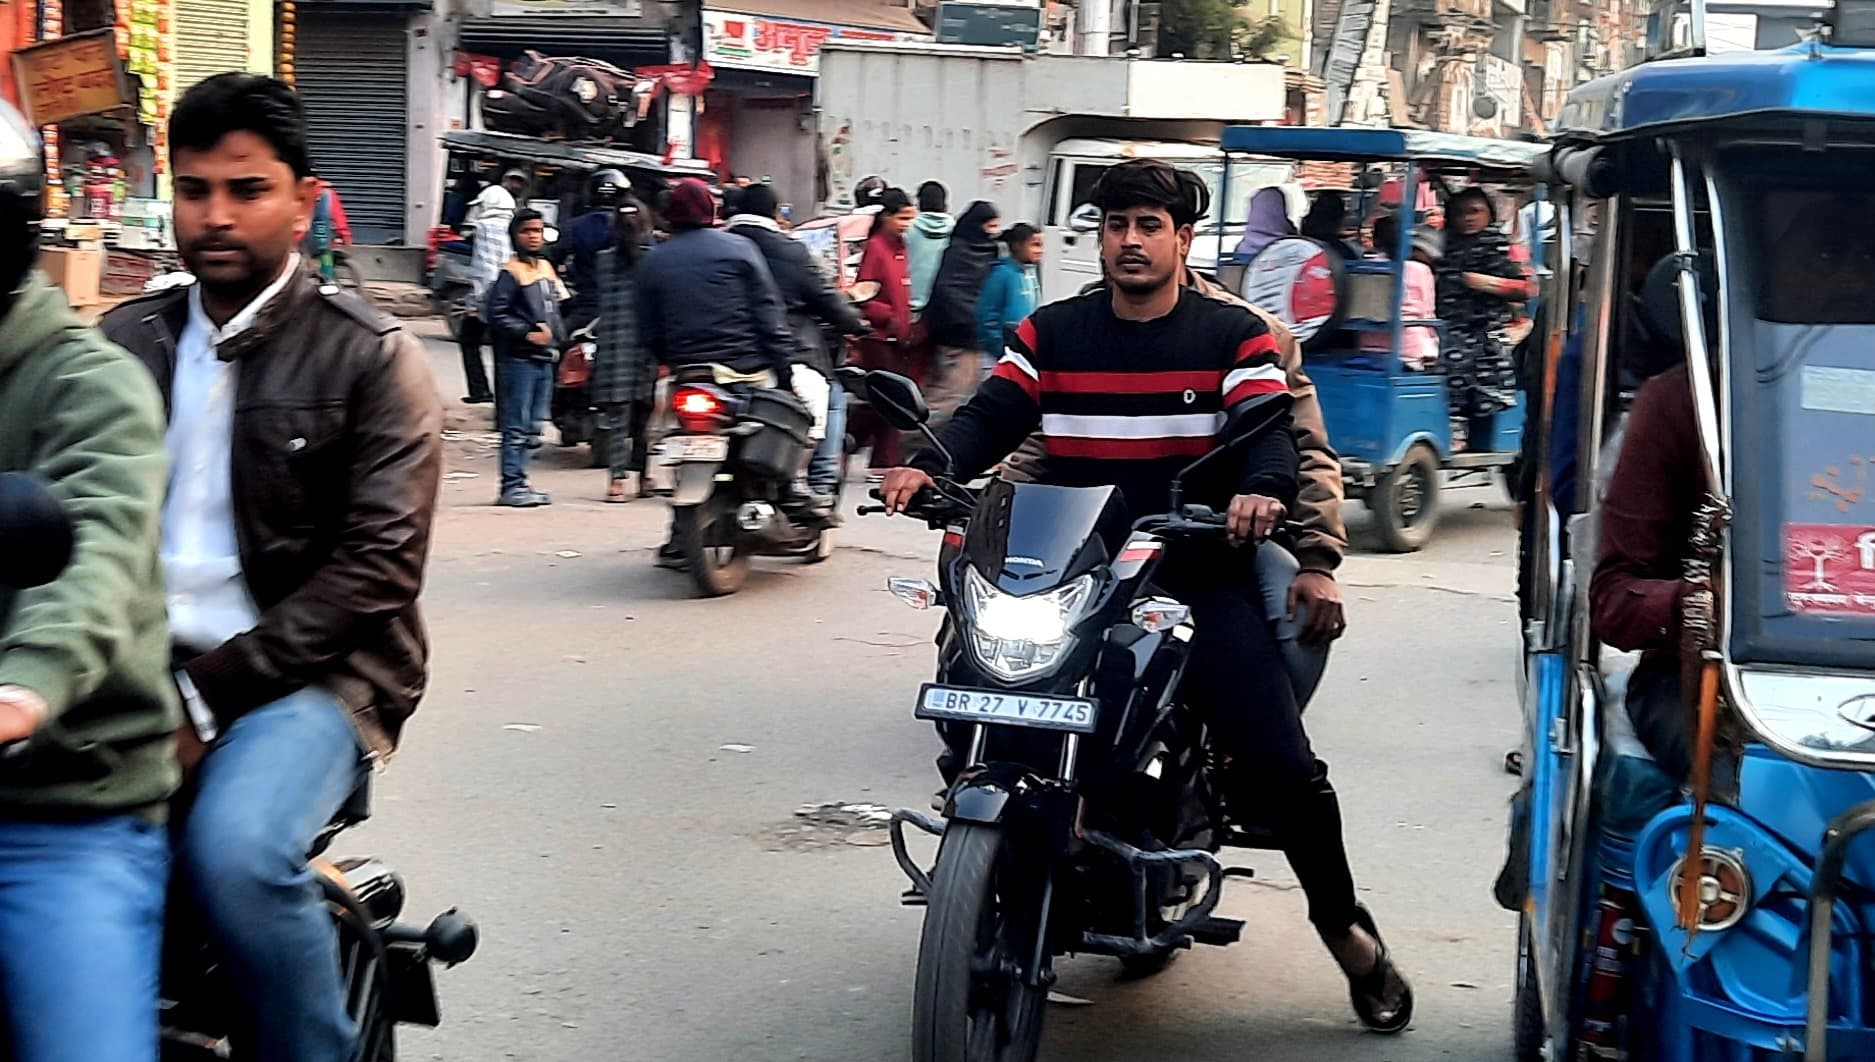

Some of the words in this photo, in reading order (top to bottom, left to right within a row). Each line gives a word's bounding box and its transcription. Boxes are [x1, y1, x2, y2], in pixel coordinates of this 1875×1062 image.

[1005, 557, 1044, 568] HONDA
[946, 693, 968, 710] BR
[979, 696, 1004, 713] 27
[1018, 699, 1028, 715] V
[1038, 701, 1089, 721] 7745
